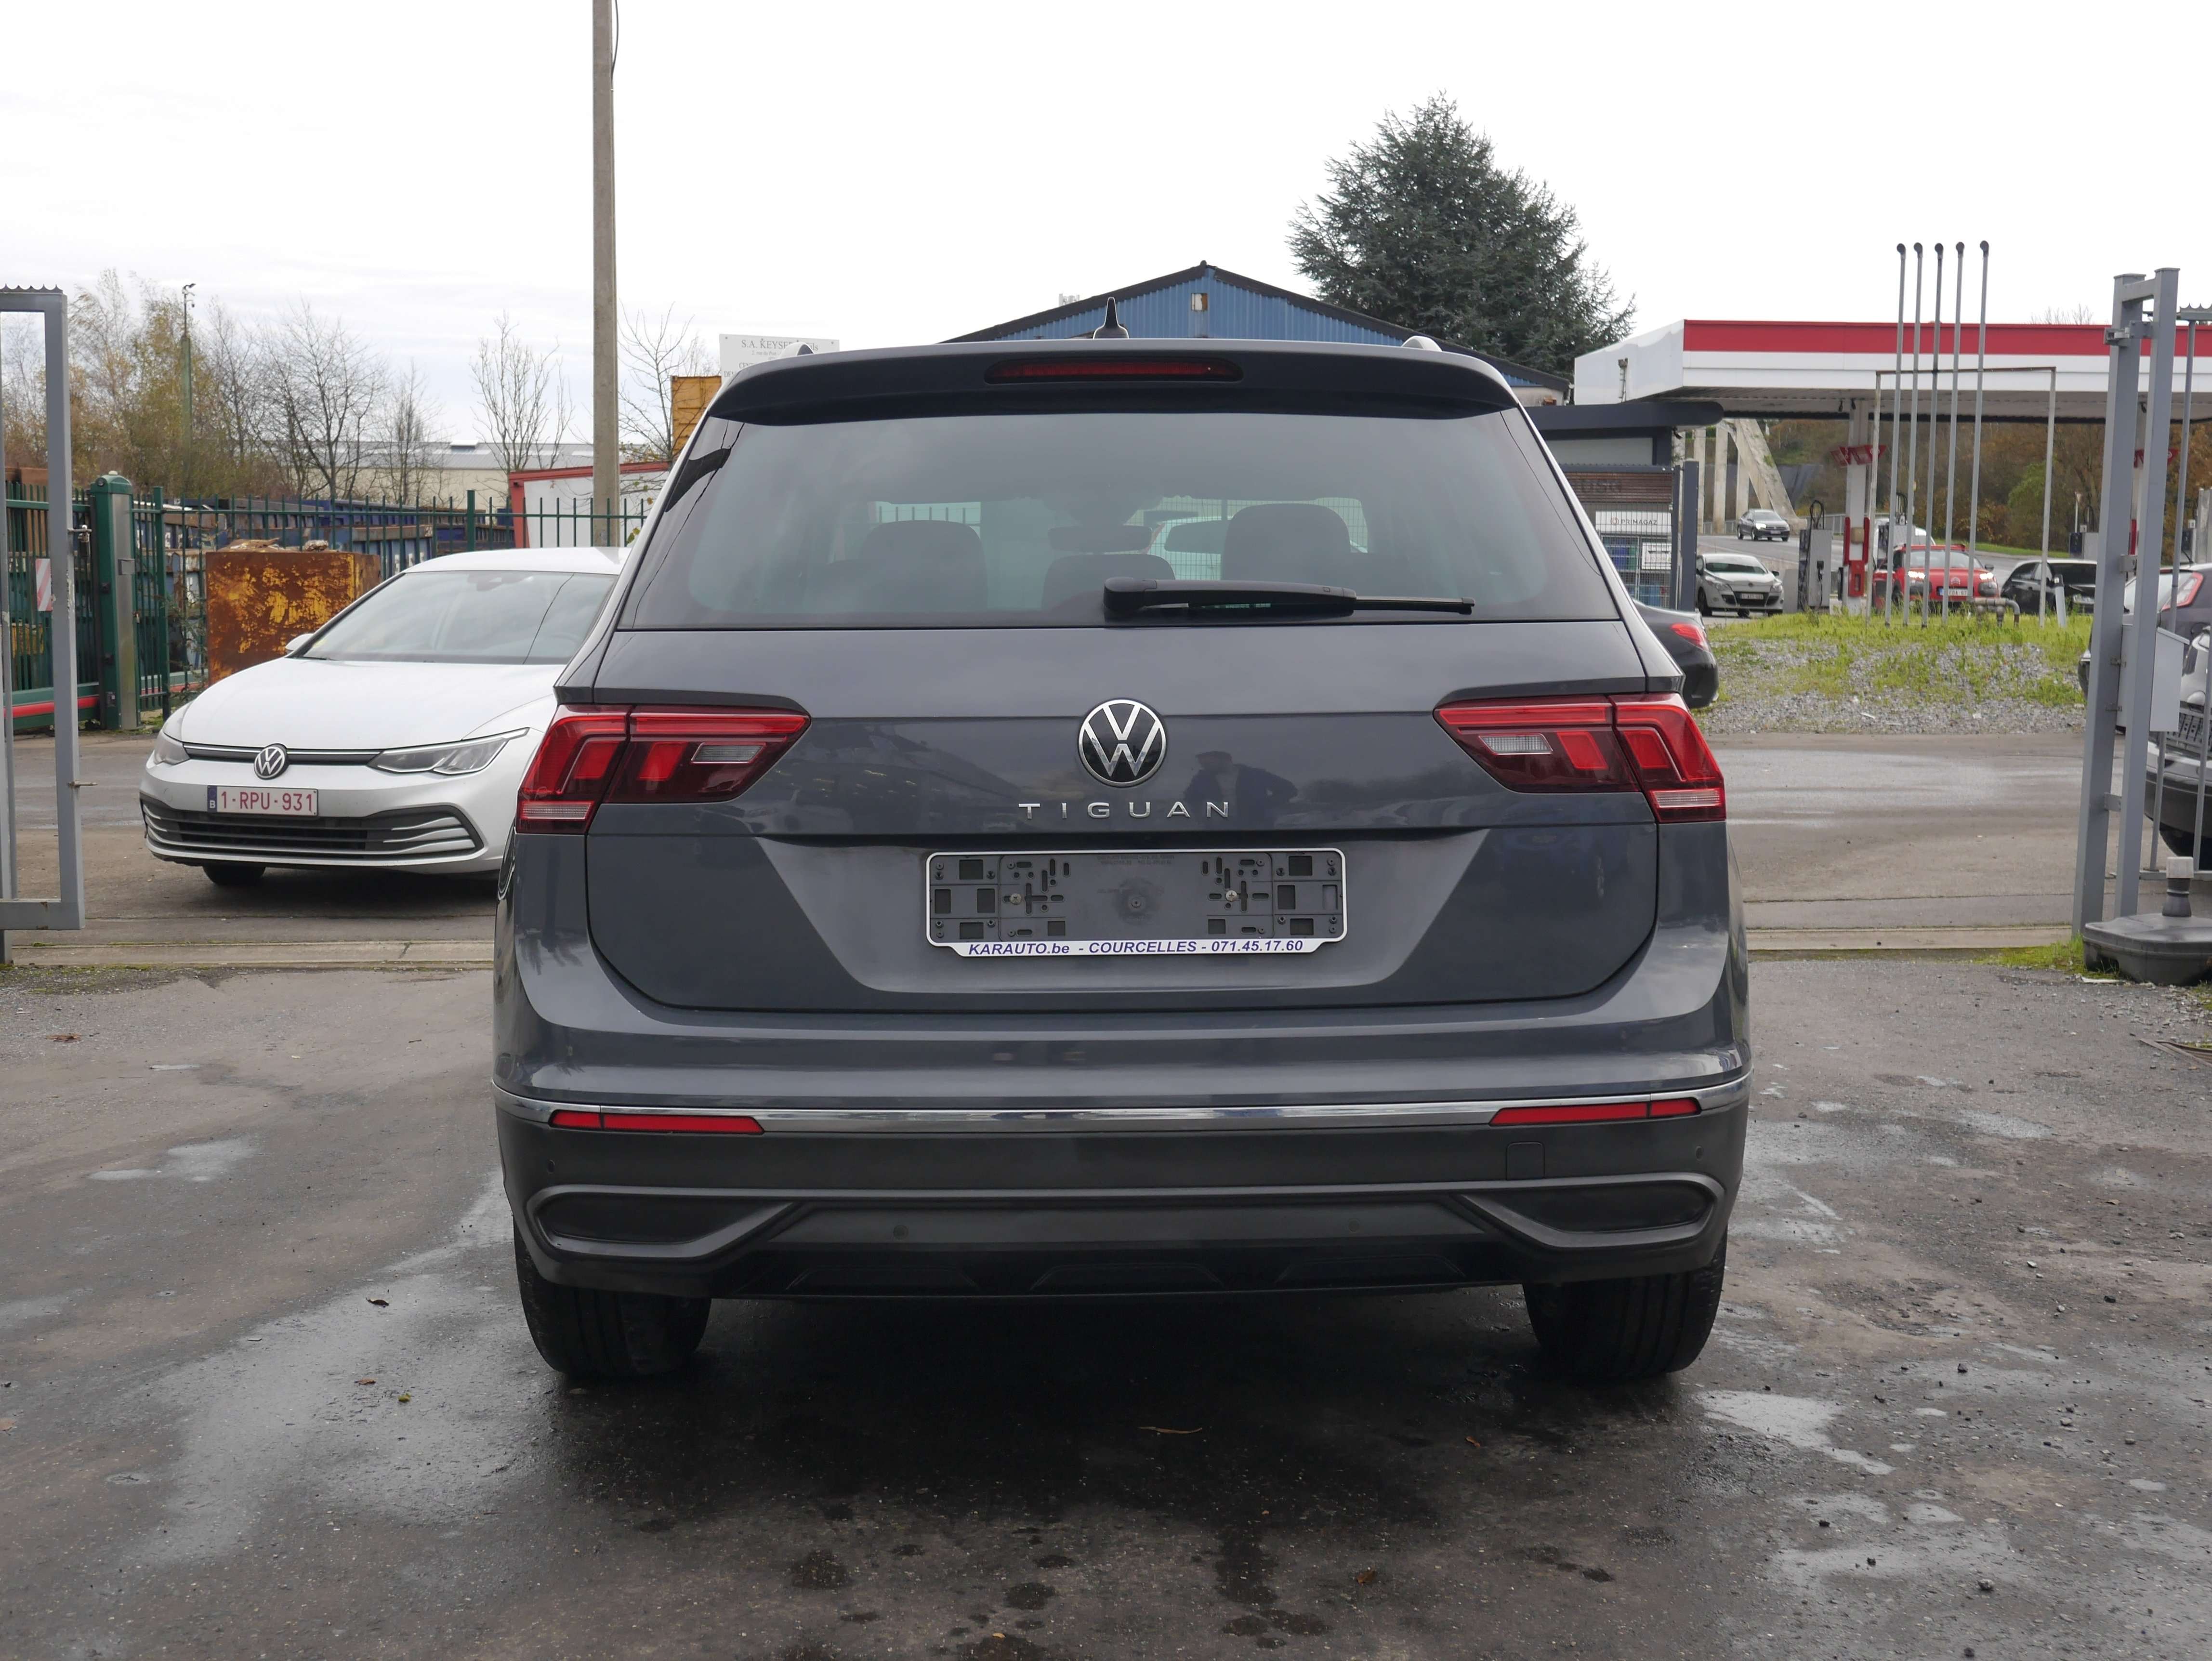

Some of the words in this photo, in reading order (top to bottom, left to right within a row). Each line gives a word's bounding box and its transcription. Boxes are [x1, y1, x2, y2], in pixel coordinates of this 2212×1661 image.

[741, 339, 758, 348] S.A.
[209, 800, 216, 809] B
[221, 791, 313, 813] 1-RPU-931
[1018, 802, 1228, 819] TIGUAN
[969, 943, 1070, 955] KARAUTO.be
[1089, 941, 1198, 954] COURCELLES
[1211, 940, 1304, 952] 071.45.17.60
